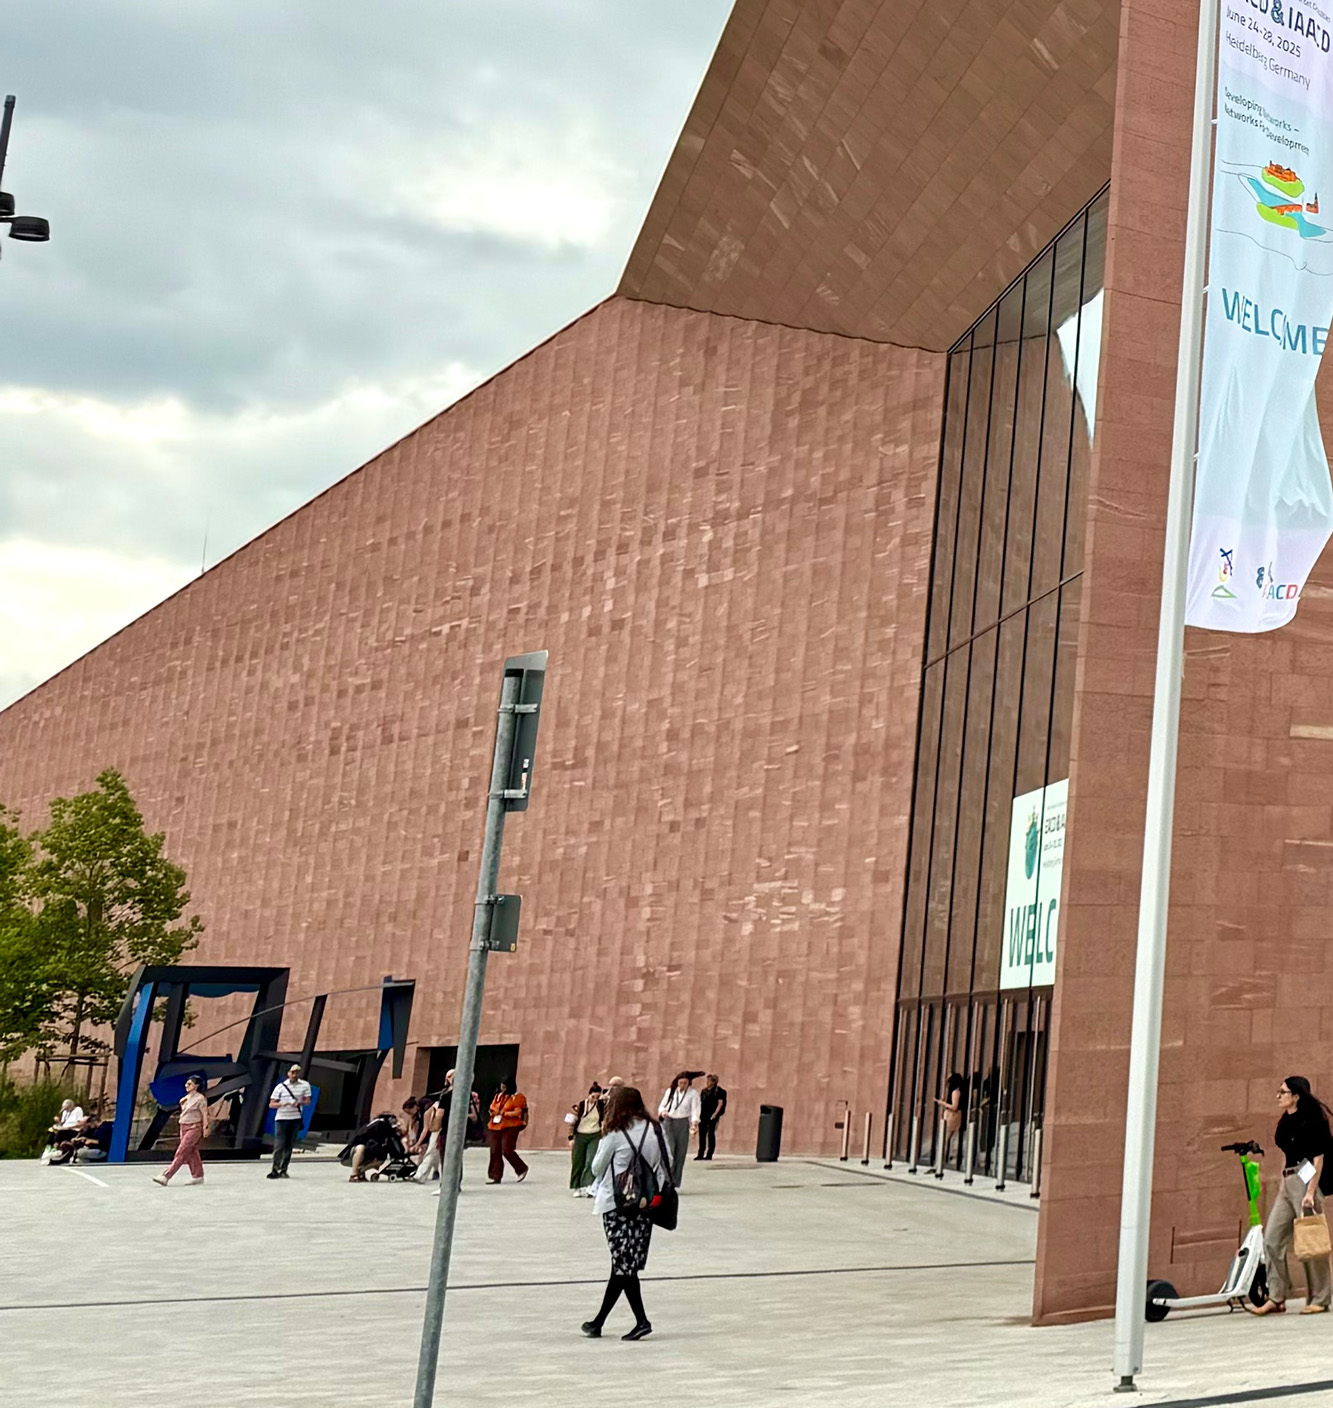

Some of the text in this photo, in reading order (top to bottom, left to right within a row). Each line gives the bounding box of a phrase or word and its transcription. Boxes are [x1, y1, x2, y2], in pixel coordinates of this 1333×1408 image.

[1226, 4, 1246, 26] June
[1276, 35, 1302, 58] 2025
[1268, 57, 1311, 91] Germany
[1222, 287, 1329, 355] WELCME
